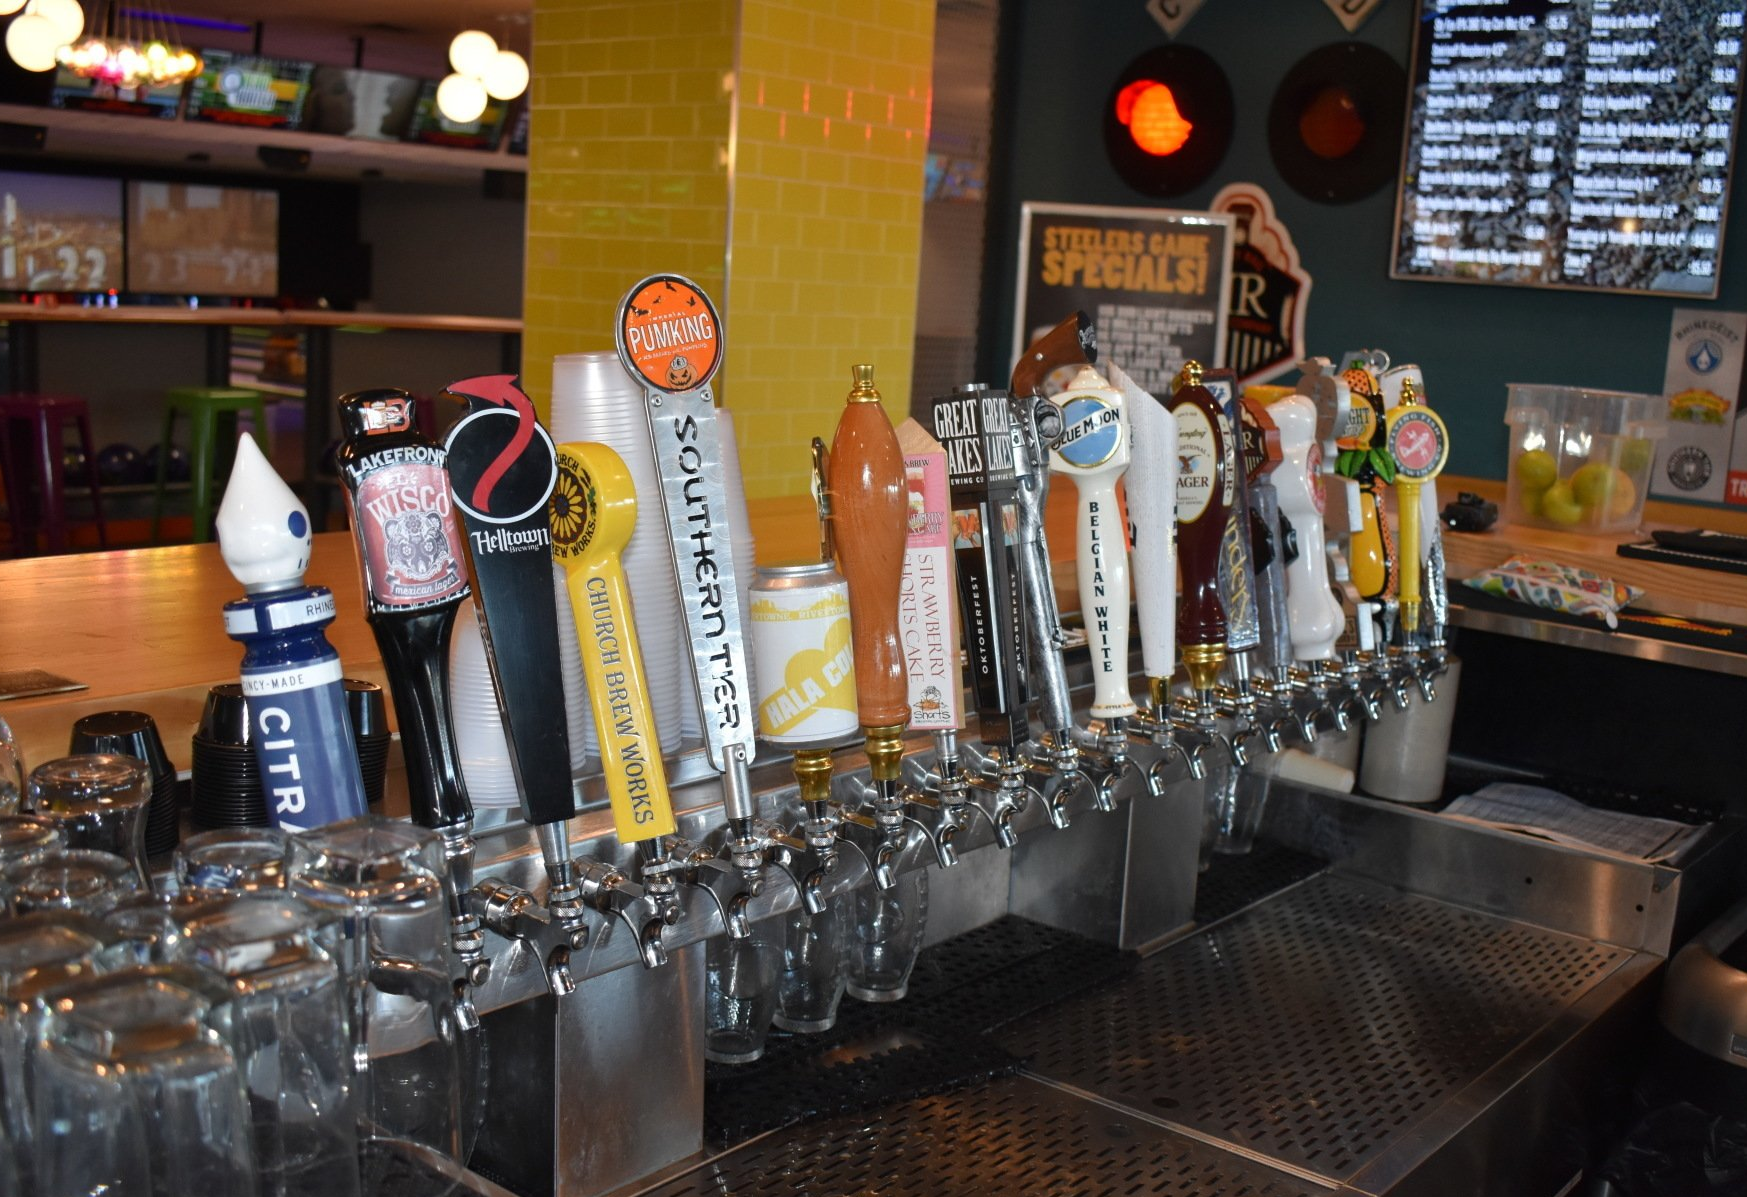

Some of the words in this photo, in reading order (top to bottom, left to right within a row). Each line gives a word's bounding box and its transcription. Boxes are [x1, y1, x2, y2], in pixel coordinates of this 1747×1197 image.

[1044, 226, 1145, 251] STEELERS
[1151, 232, 1210, 257] GAME
[1042, 250, 1207, 295] SPECIALS!
[628, 312, 713, 354] PUMKING
[934, 399, 978, 439] GREAT
[982, 397, 1009, 433] GREAT
[346, 446, 447, 478] LAKEFRONT
[948, 437, 983, 475] AKES
[986, 435, 1013, 471] LAKES
[951, 477, 973, 486] EWING
[1177, 476, 1209, 488] AGER
[470, 527, 550, 555] Helltown
[674, 414, 727, 638] SOUTHERN
[509, 543, 540, 554] Brewing
[1088, 501, 1105, 597] BELGIAN
[395, 585, 433, 597] mexican
[586, 576, 621, 666] CHURCH
[918, 554, 945, 680] STRAWBERRY
[970, 576, 989, 674] OKTOBERFEST
[1010, 573, 1022, 672] OKTOBERFEST
[905, 629, 925, 684] CAKE
[1095, 606, 1113, 673] WHITE
[606, 671, 641, 738] BREW
[765, 677, 826, 729] HALA
[621, 741, 654, 825] WORKS
